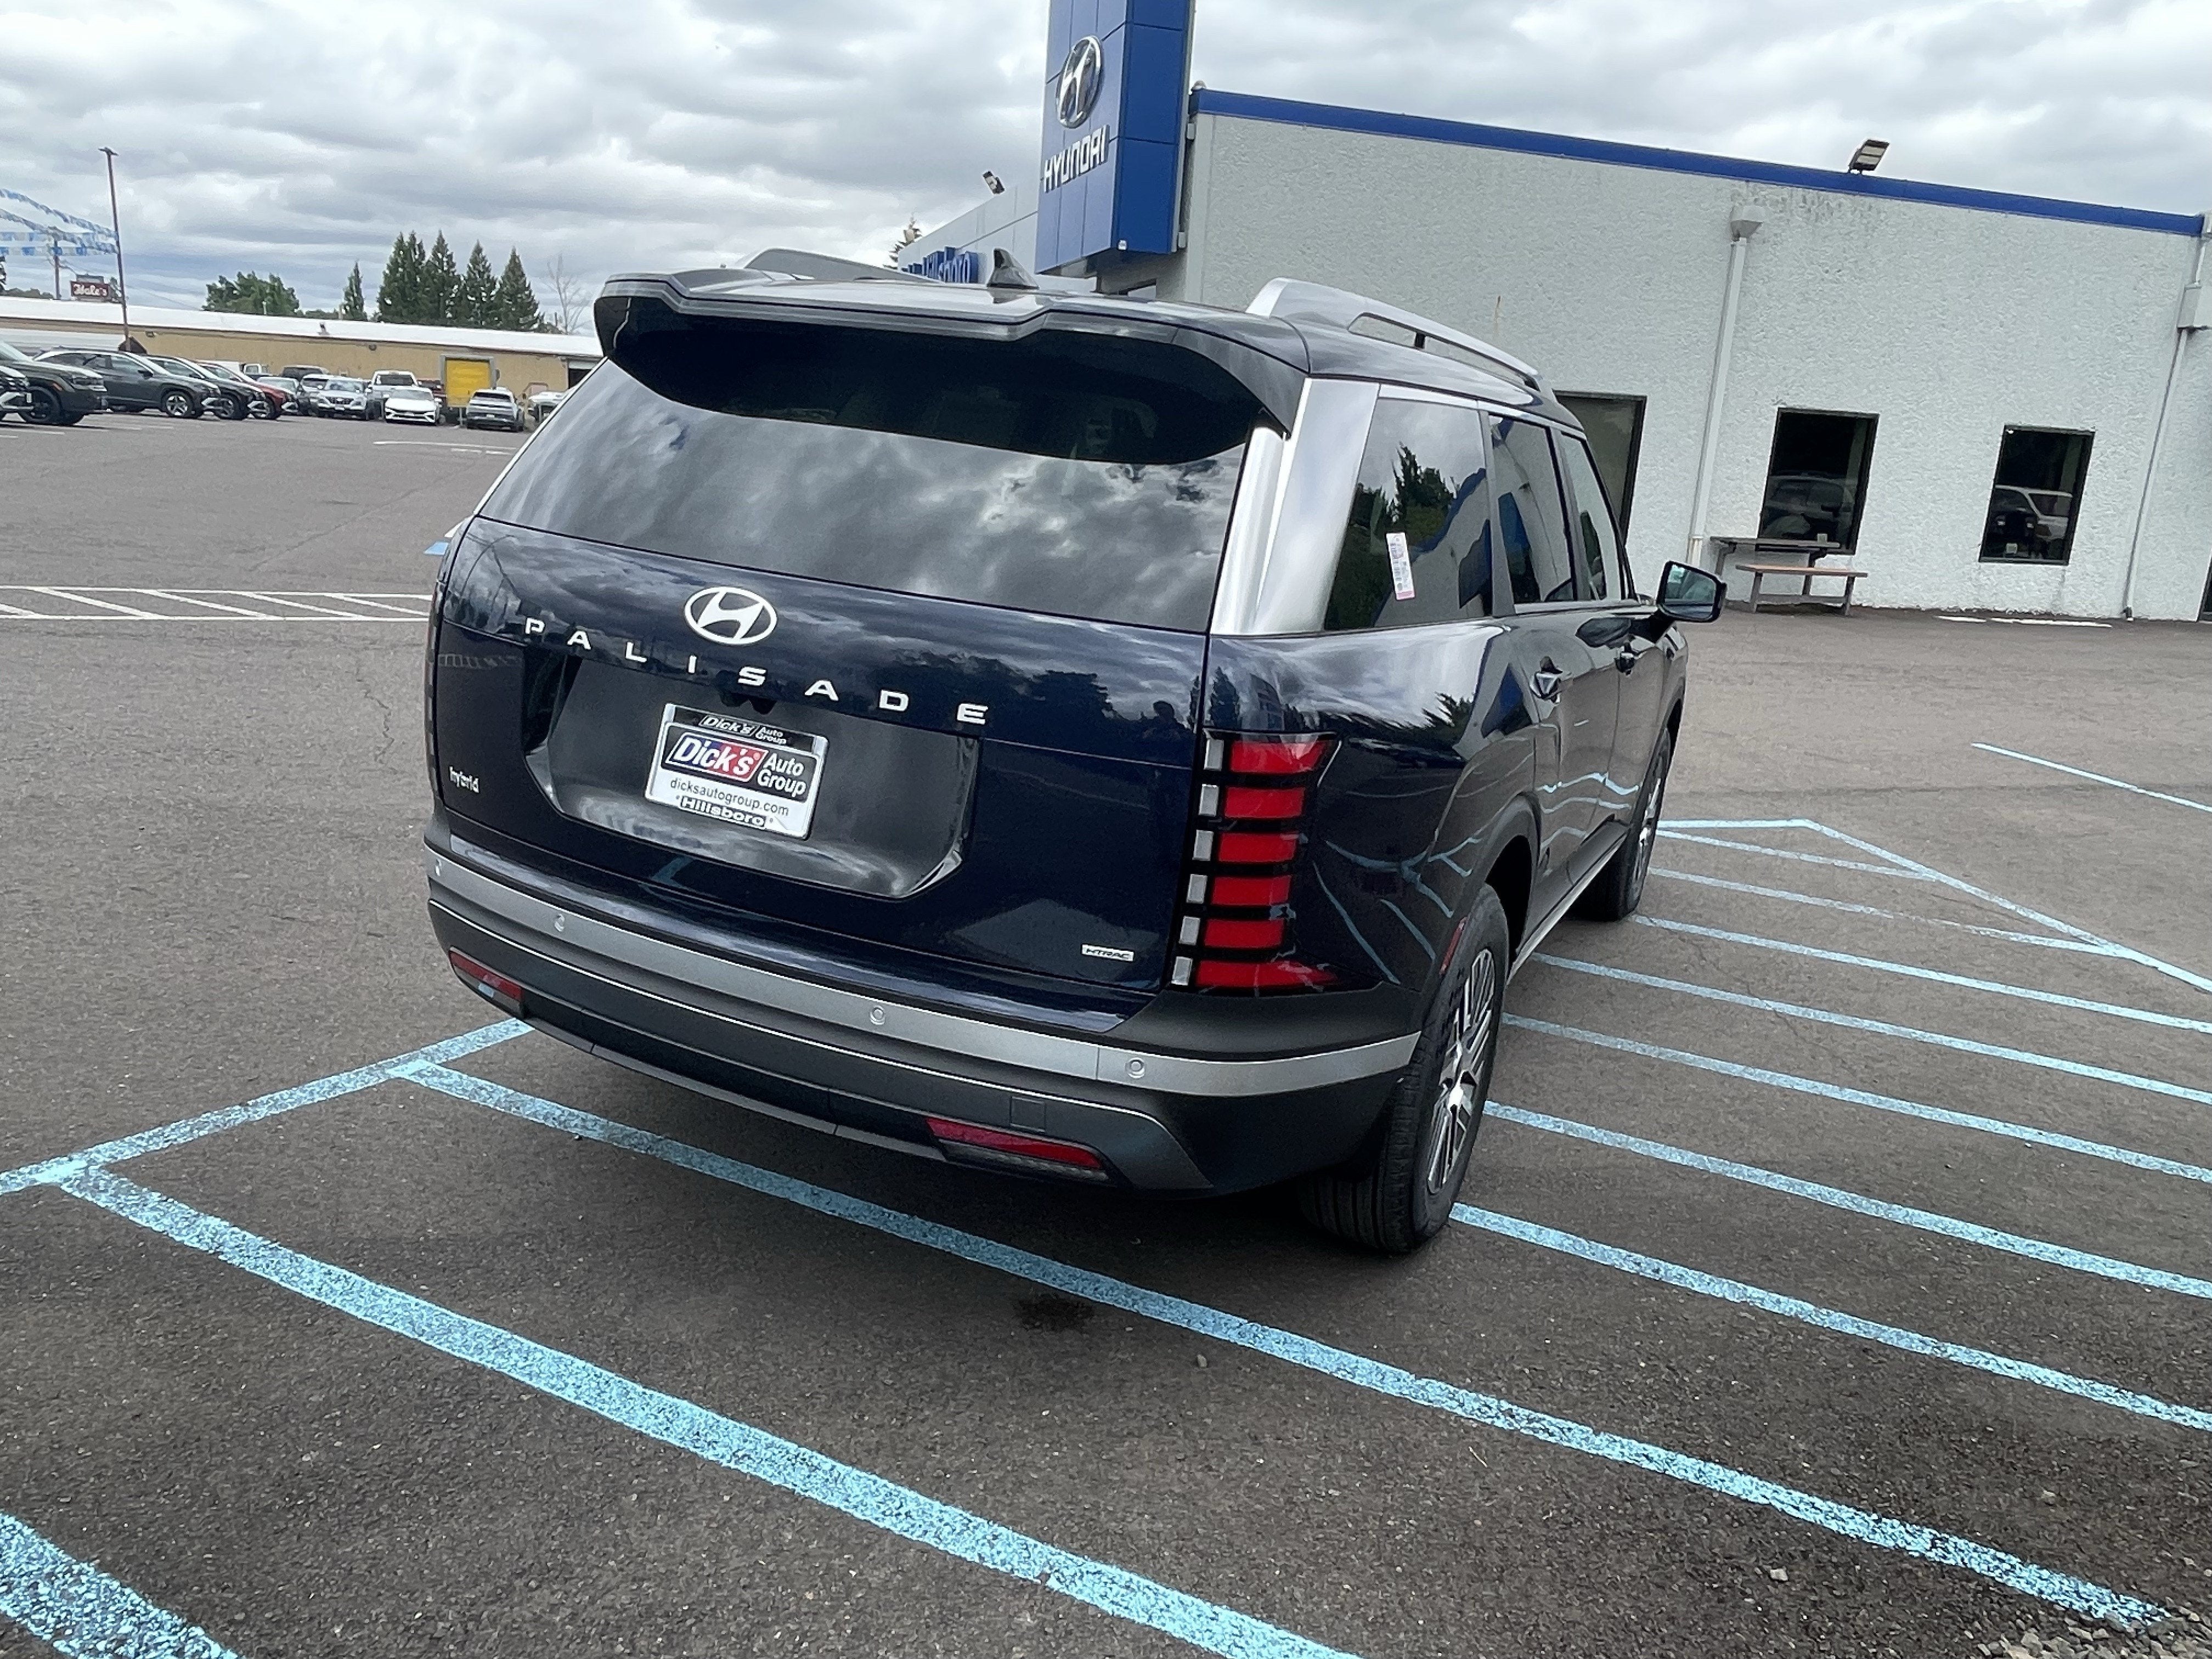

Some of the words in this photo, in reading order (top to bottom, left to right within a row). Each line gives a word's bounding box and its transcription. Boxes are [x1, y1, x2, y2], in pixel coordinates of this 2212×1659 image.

[1044, 124, 1107, 193] HYUNDAI
[524, 617, 989, 725] PALISADE
[702, 716, 755, 735] Dick's
[755, 730, 787, 745] Group
[758, 726, 783, 738] Auto
[673, 737, 754, 776] Dick's
[763, 753, 804, 776] Auto
[450, 766, 479, 793] hybrid
[757, 768, 806, 797] Group
[670, 777, 789, 817] dicksautogroup.com
[681, 797, 766, 827] Hillsboro
